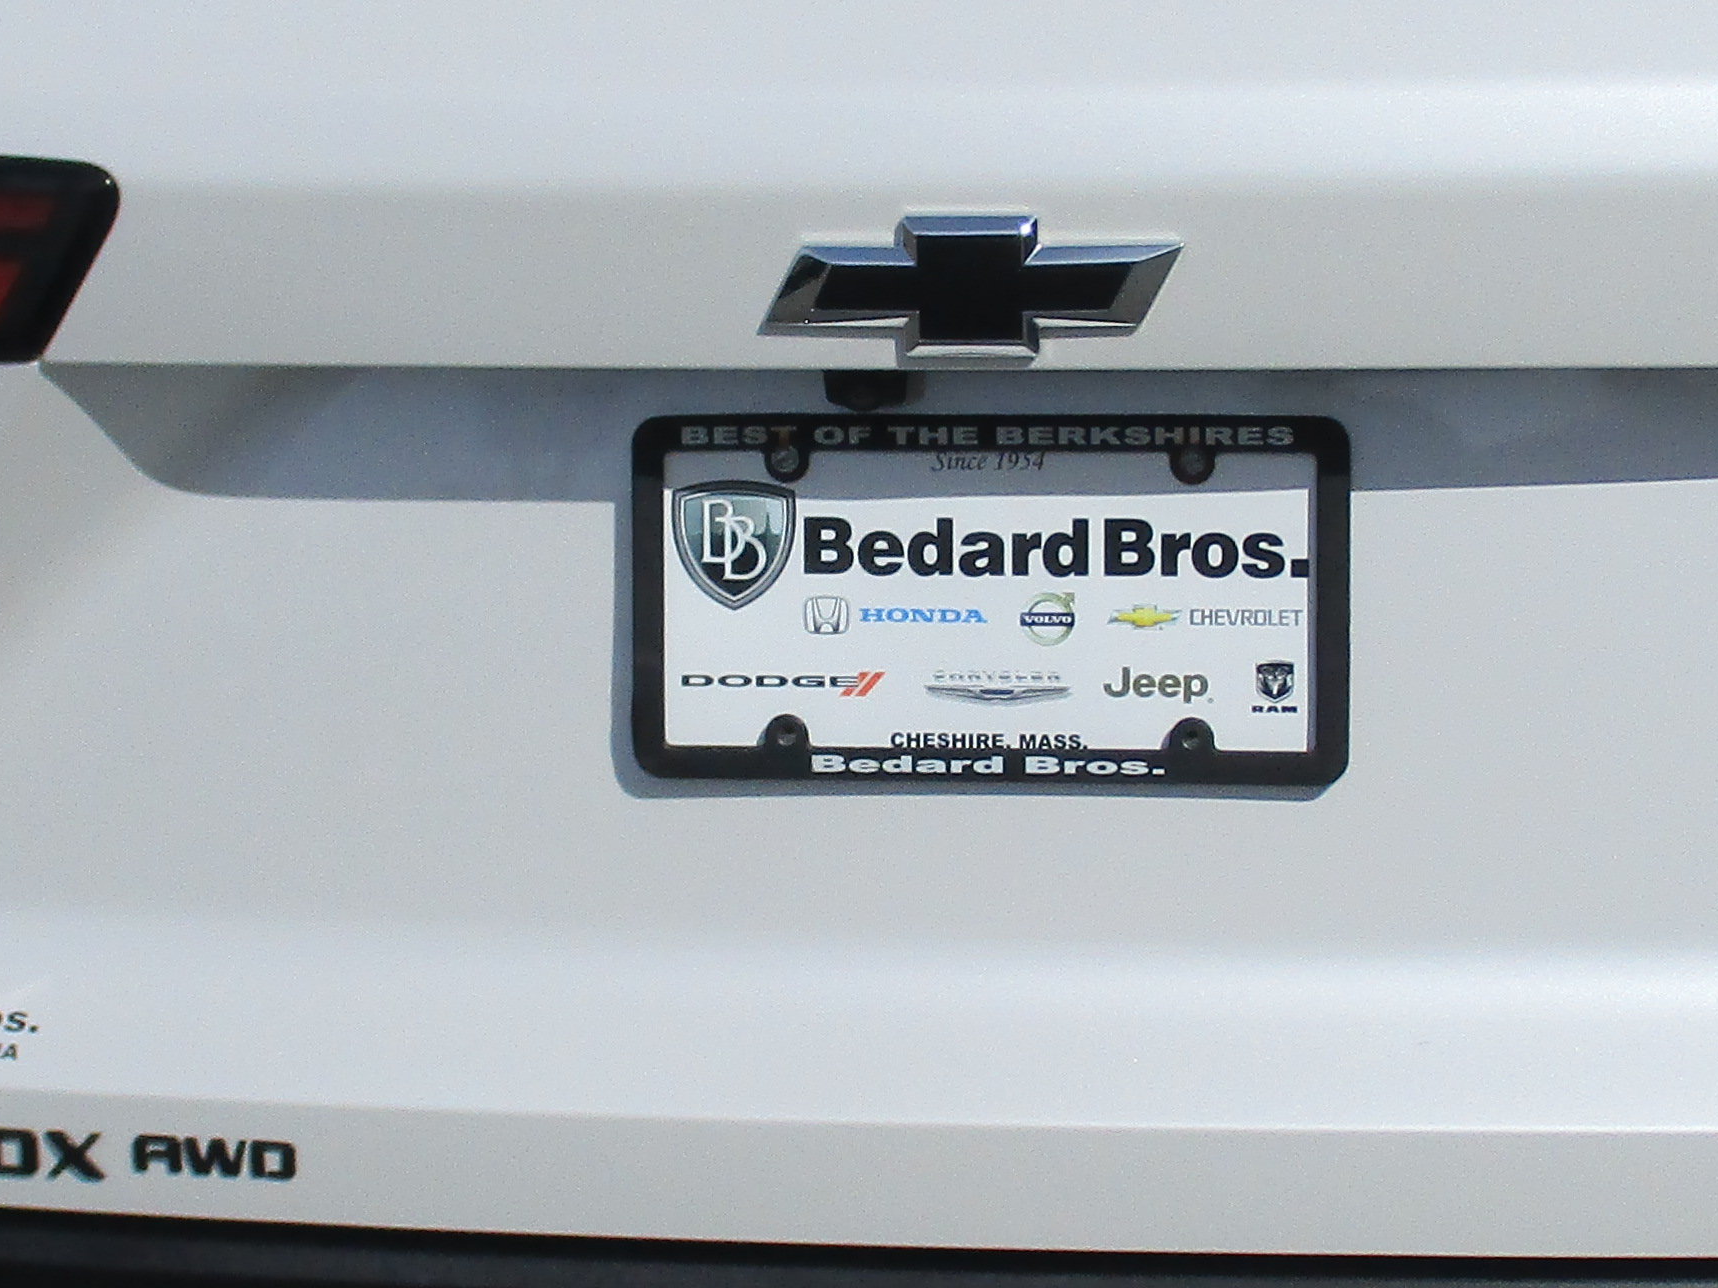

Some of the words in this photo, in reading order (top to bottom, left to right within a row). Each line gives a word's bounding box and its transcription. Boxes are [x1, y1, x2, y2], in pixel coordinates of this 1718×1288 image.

[681, 425, 798, 446] BEST
[813, 425, 873, 446] OF
[887, 425, 980, 446] THE
[994, 425, 1295, 447] BERKSHIRES
[930, 451, 988, 472] Since
[993, 451, 1046, 472] 1954
[802, 515, 1090, 579] Bedard
[1103, 517, 1310, 579] Bros.
[858, 607, 989, 624] HONDA
[1022, 613, 1073, 625] VOLVO
[1188, 608, 1304, 627] CHEVROLET
[681, 674, 859, 688] DODGE
[1103, 666, 1210, 704] Jeep
[1251, 705, 1298, 713] RAM
[1019, 733, 1089, 750] MASS.
[810, 753, 1004, 775] Bedard
[1024, 755, 1166, 776] Bros.
[130, 1132, 299, 1182] AWD
